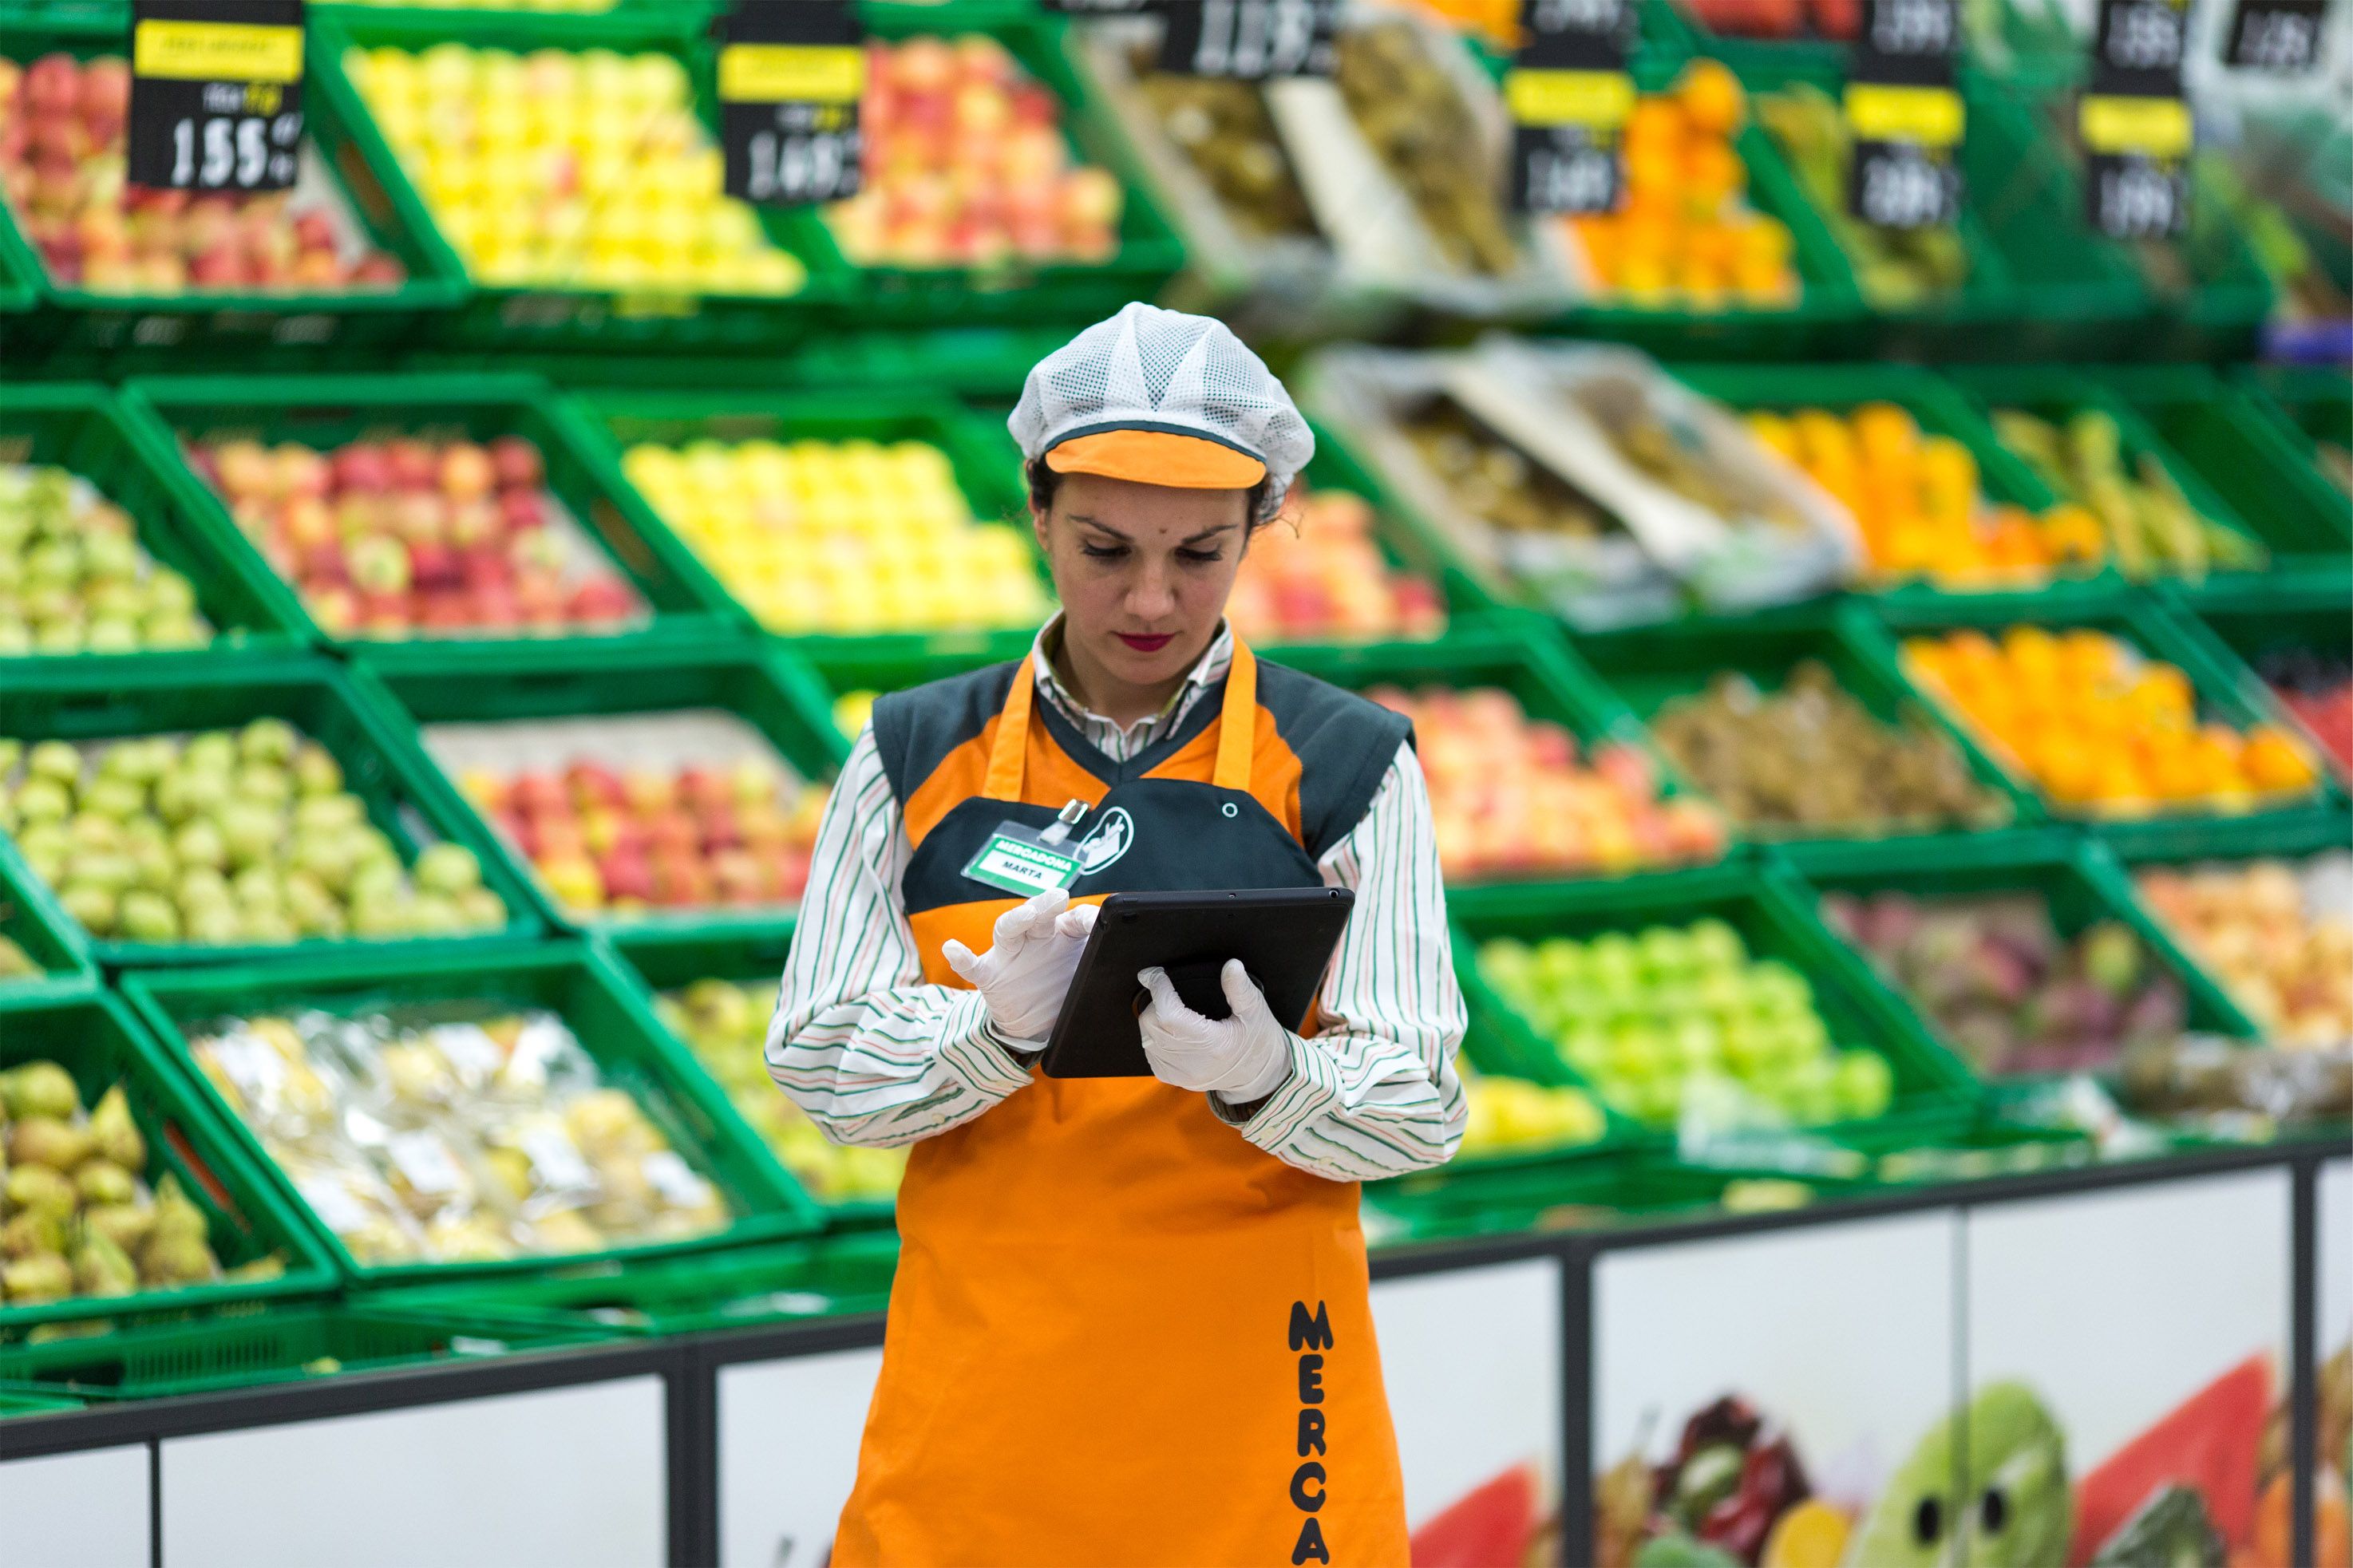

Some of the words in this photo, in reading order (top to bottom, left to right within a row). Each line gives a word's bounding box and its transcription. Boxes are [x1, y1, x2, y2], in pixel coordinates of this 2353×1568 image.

[995, 839, 1072, 871] MERCADONA
[1002, 861, 1042, 879] MARTA
[1288, 1300, 1334, 1566] MERCA
